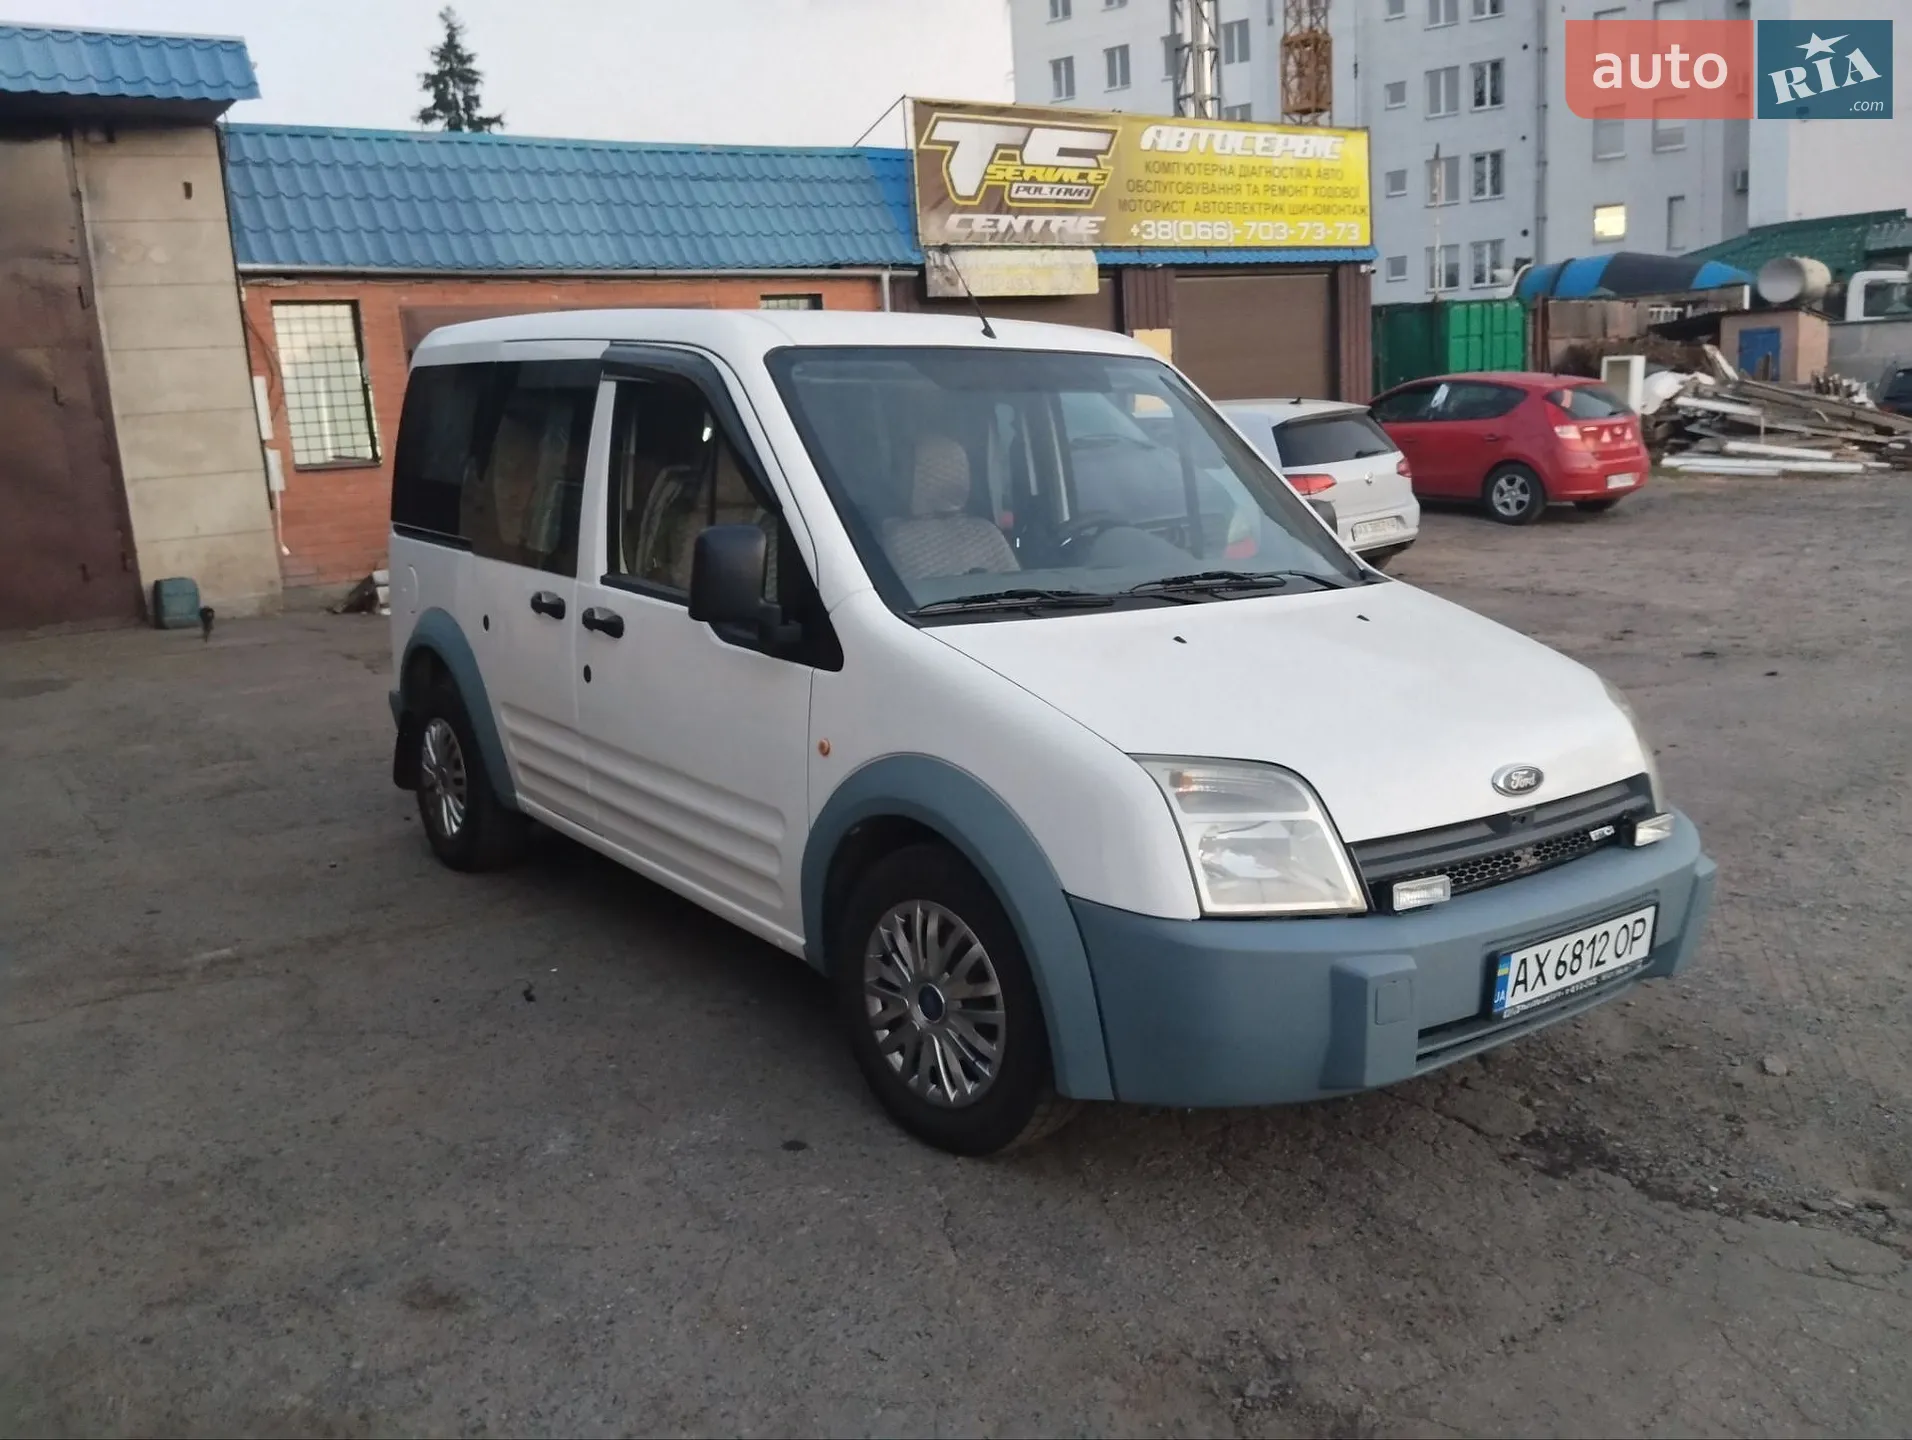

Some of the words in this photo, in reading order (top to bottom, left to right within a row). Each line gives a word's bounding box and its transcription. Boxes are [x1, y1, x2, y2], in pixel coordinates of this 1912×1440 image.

[1140, 125, 1345, 160] АВТОСЕРВІС
[984, 164, 1108, 185] SERVICE
[1315, 168, 1344, 181] АВТО
[1013, 184, 1092, 199] POLTAVA
[1126, 179, 1242, 196] ОБСЛУГОВУВАННЯ
[1246, 183, 1260, 197] ТА
[1263, 184, 1309, 198] РЕМОНТ
[1193, 201, 1285, 217] АВТОЕЛЕКТРИК
[944, 213, 1106, 235] CENTRE
[1511, 770, 1536, 789] Ford
